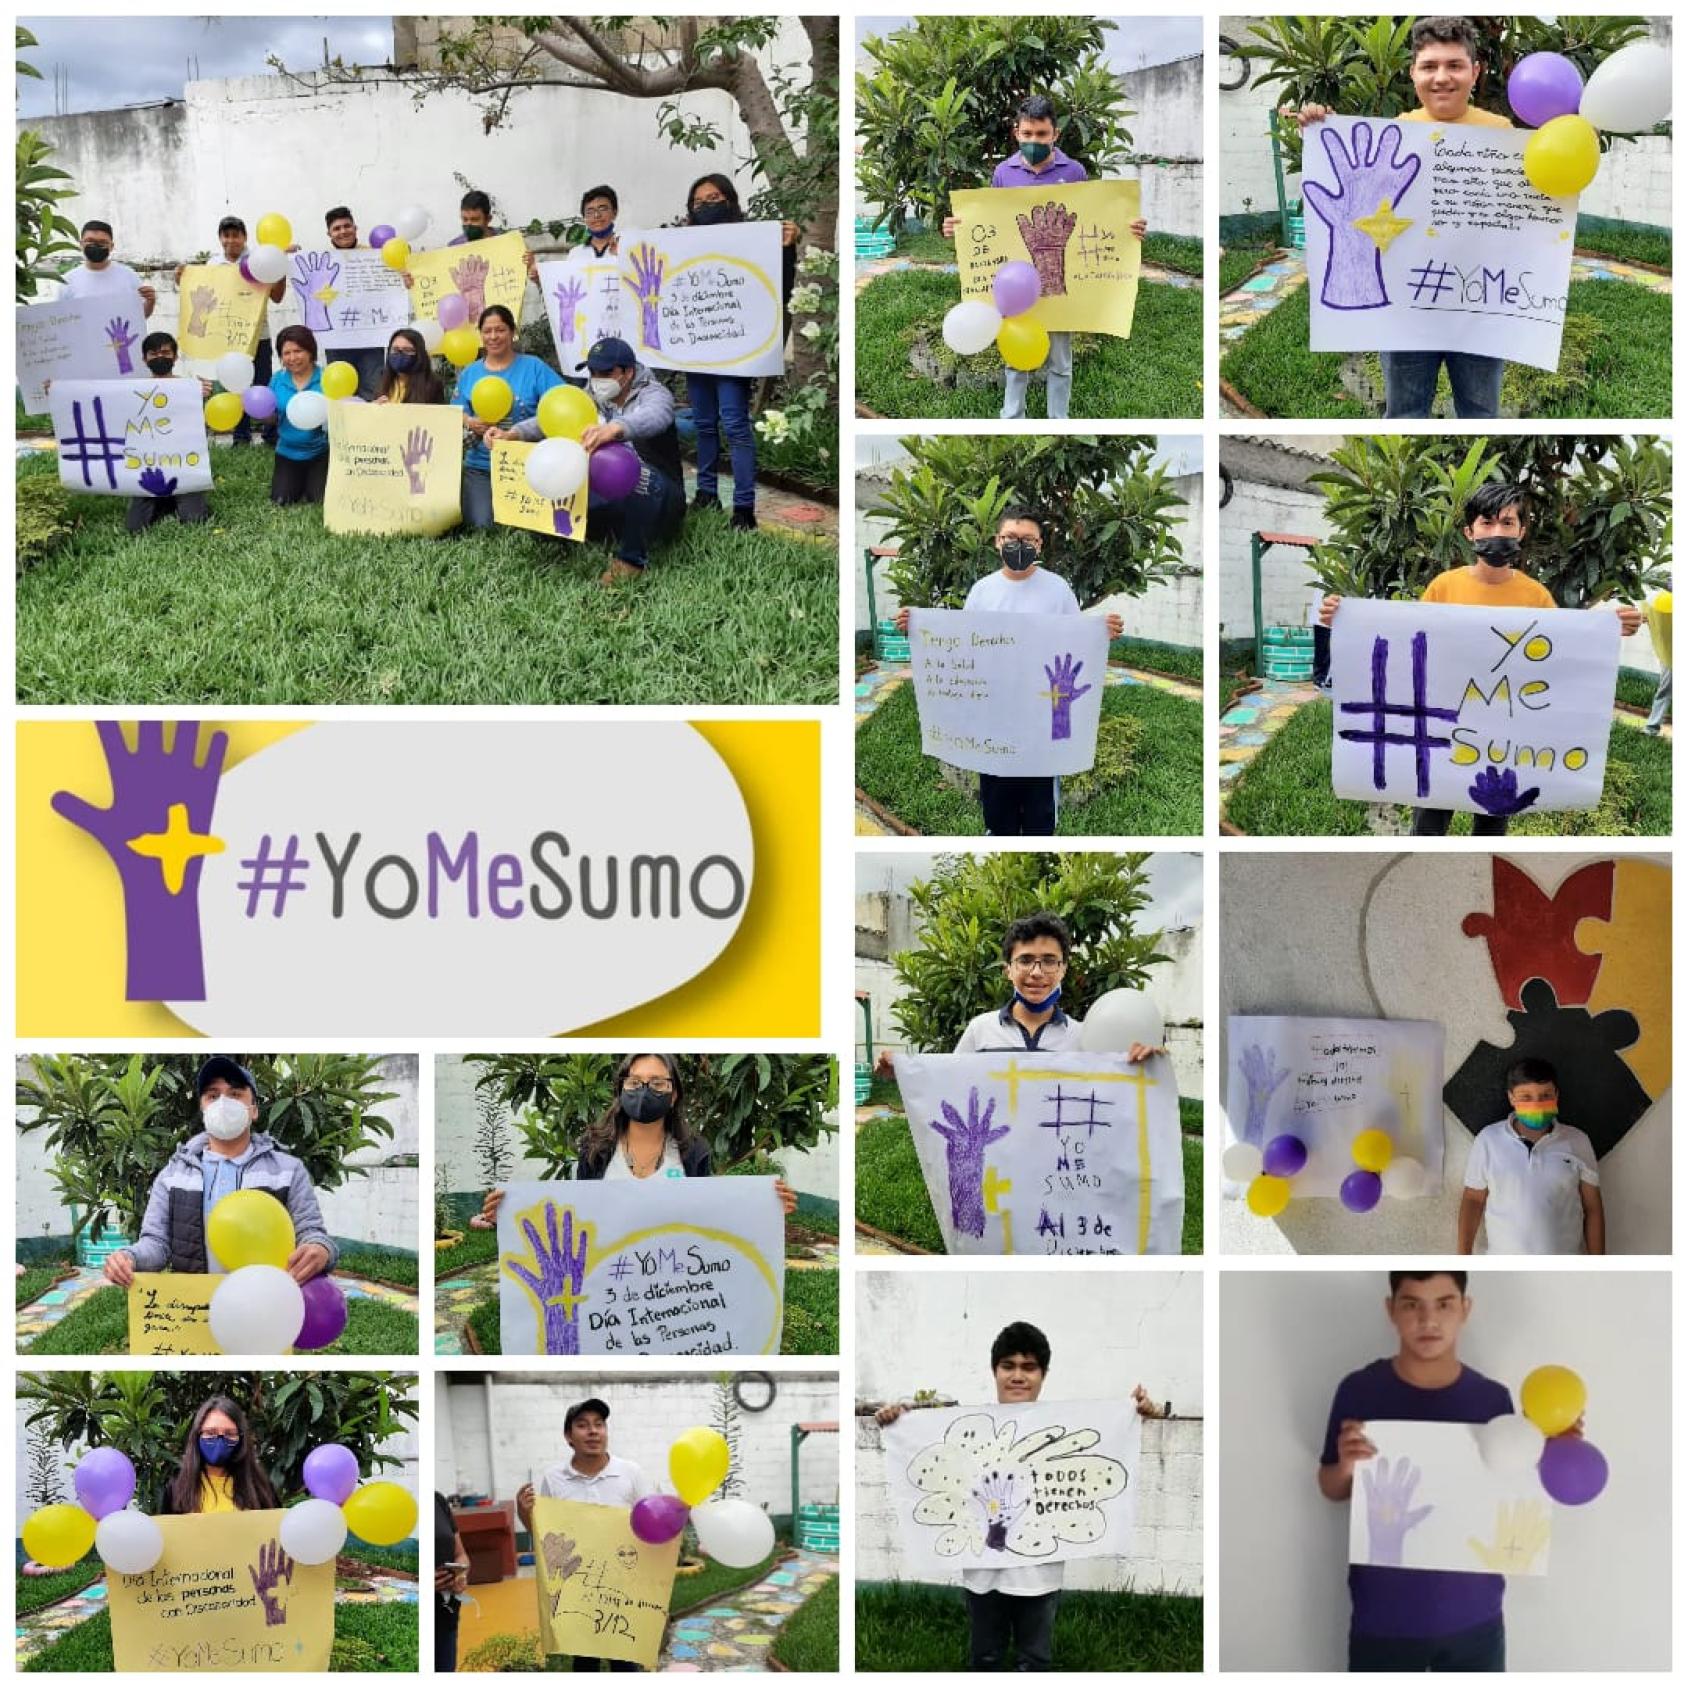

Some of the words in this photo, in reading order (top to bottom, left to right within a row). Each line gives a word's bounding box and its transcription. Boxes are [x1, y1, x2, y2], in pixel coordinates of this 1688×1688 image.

[1406, 259, 1567, 311] #YoMeSumo
[134, 385, 168, 416] Yo
[125, 416, 173, 439] Me
[124, 447, 199, 469] Sumo
[1491, 620, 1552, 673] Yo
[1458, 675, 1550, 718] Me
[1449, 727, 1588, 771] Sumo
[237, 831, 745, 919] #YoMeSumo
[1077, 1215, 1087, 1236] 3
[1093, 1214, 1112, 1237] de
[624, 1285, 640, 1302] de
[643, 1280, 715, 1300] diciembre
[628, 1292, 727, 1326] Internacional
[606, 1330, 623, 1350] de
[631, 1330, 651, 1347] las
[657, 1320, 716, 1343] Personas
[150, 1567, 234, 1588] Internacional
[181, 1583, 237, 1601] personas
[160, 1607, 182, 1618] con
